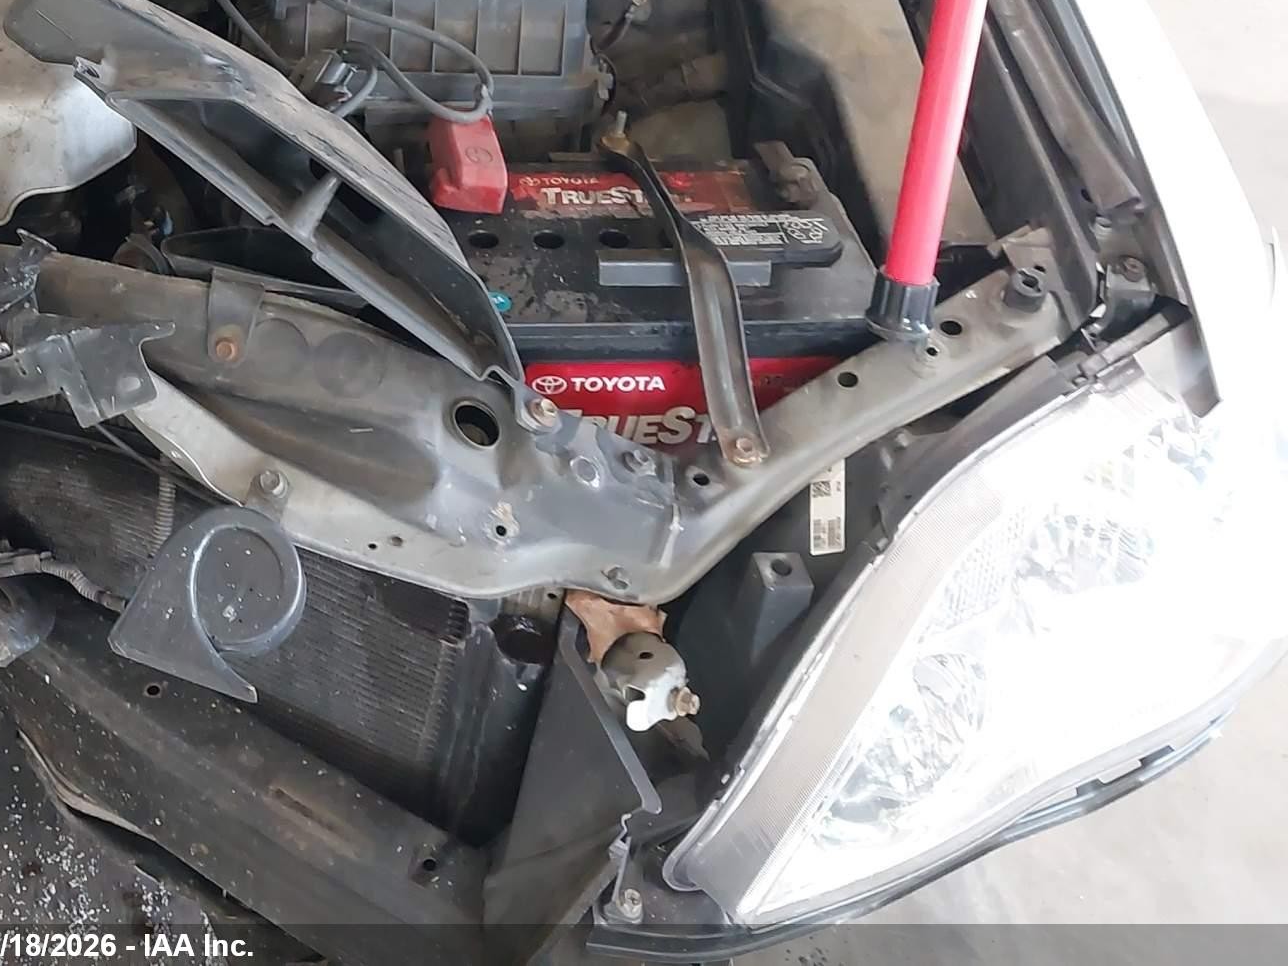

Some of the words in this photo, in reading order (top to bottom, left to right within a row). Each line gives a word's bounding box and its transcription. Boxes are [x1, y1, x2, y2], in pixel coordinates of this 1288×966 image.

[541, 177, 600, 186] TOYOTA
[539, 186, 646, 205] TRUEST
[570, 376, 667, 392] TOYOTA
